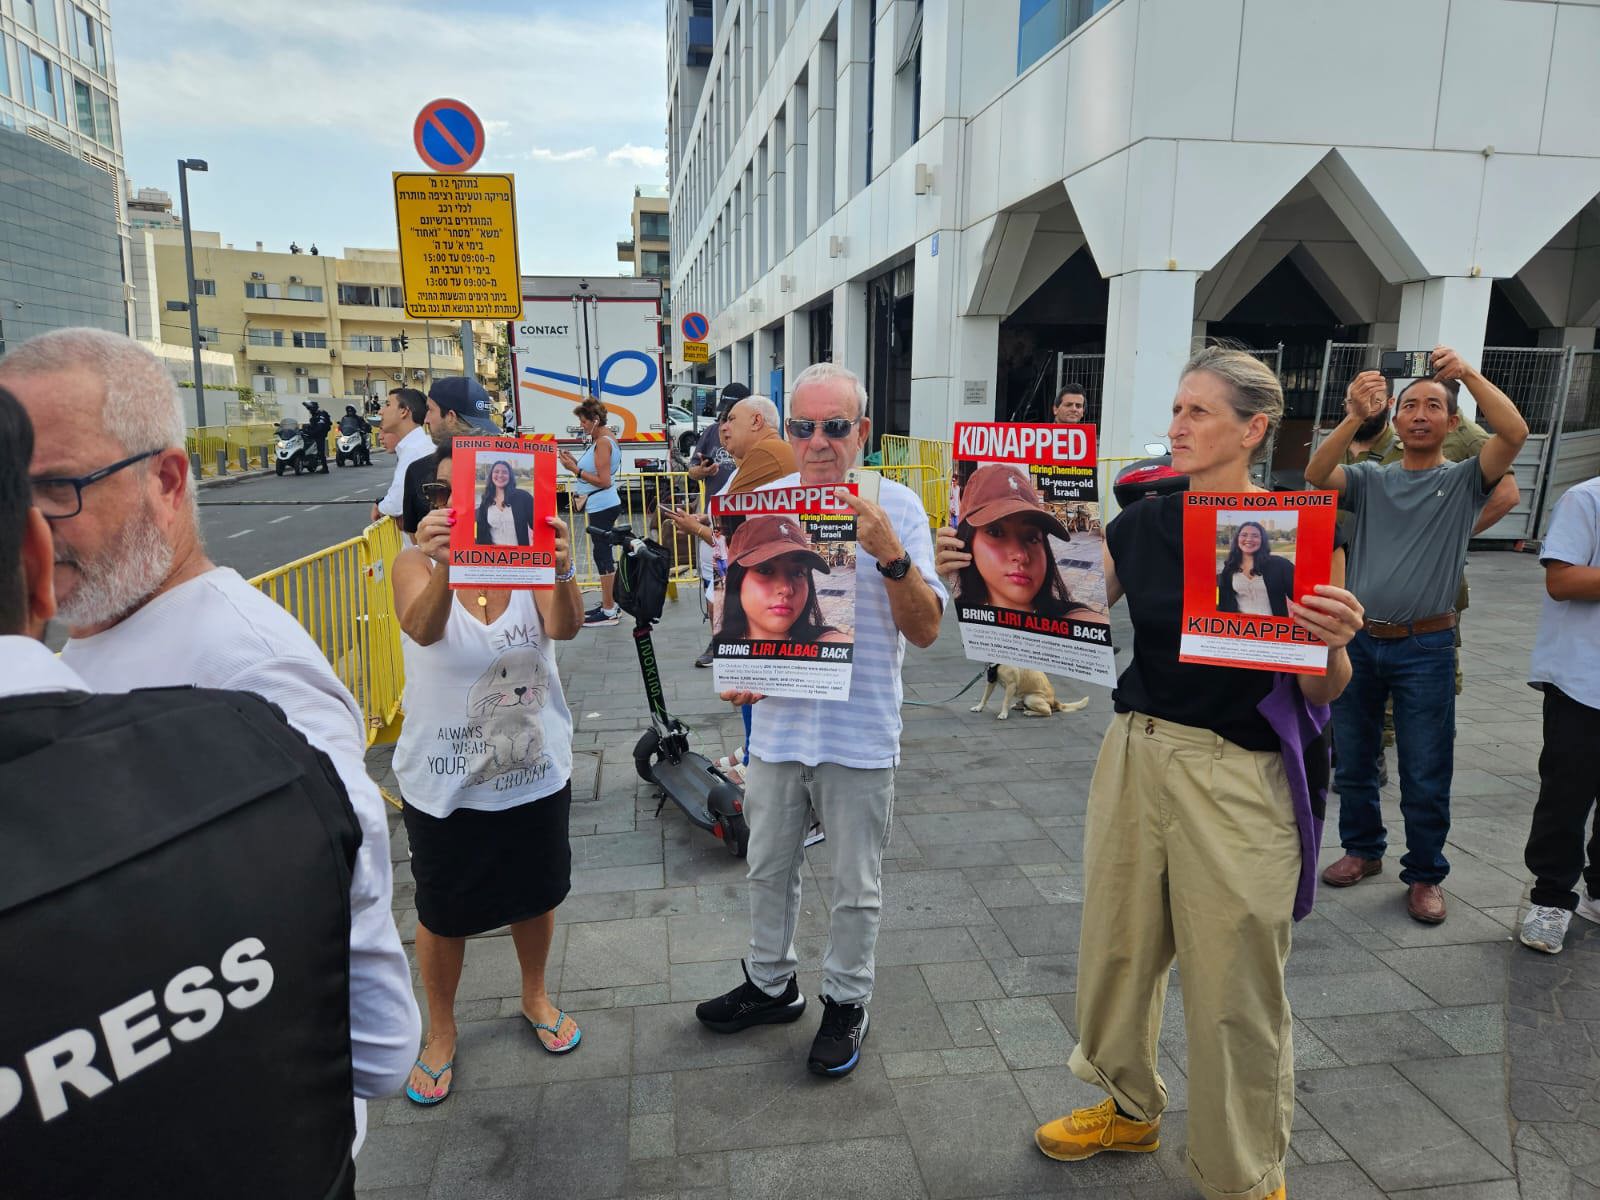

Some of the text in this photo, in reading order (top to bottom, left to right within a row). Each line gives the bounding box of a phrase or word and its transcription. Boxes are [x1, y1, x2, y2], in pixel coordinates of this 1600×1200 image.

[440, 180, 448, 188] 12
[400, 192, 509, 202] פריקה וטעינה רציפה מותרת
[438, 204, 472, 213] לכלי רכב
[420, 217, 492, 225] המוגדרים ברשיונם
[444, 242, 454, 250] עד
[467, 242, 483, 250] בימי
[424, 254, 446, 262] 15:00
[450, 254, 459, 262] עד
[430, 266, 440, 274] חג
[442, 266, 463, 274] וערבי
[473, 266, 490, 274] בימי
[426, 278, 448, 286] 13:00
[451, 278, 461, 286] עד
[418, 292, 507, 301] ביתר הימים והשעות החניה
[520, 325, 569, 335] CONTACT
[455, 440, 555, 452] BRING NOA HOME
[958, 426, 1088, 460] KIDNAPPED
[1029, 465, 1093, 476] #BringThemHome
[1041, 478, 1094, 488] 18-years-old
[1053, 487, 1080, 498] Israeli
[1188, 495, 1333, 507] BRING NOA HOME
[810, 523, 853, 532] 18-years-old
[820, 531, 842, 539] Israeli
[454, 550, 552, 565] KIDNAPPED
[962, 607, 1107, 642] BRING LIRI ALBAG BACK
[718, 642, 850, 659] BRING LIRI ALBAG BACK
[640, 638, 661, 697] INOKIM
[437, 725, 483, 740] ALWAYS
[452, 741, 487, 755] WEAR
[427, 756, 466, 775] YOUR
